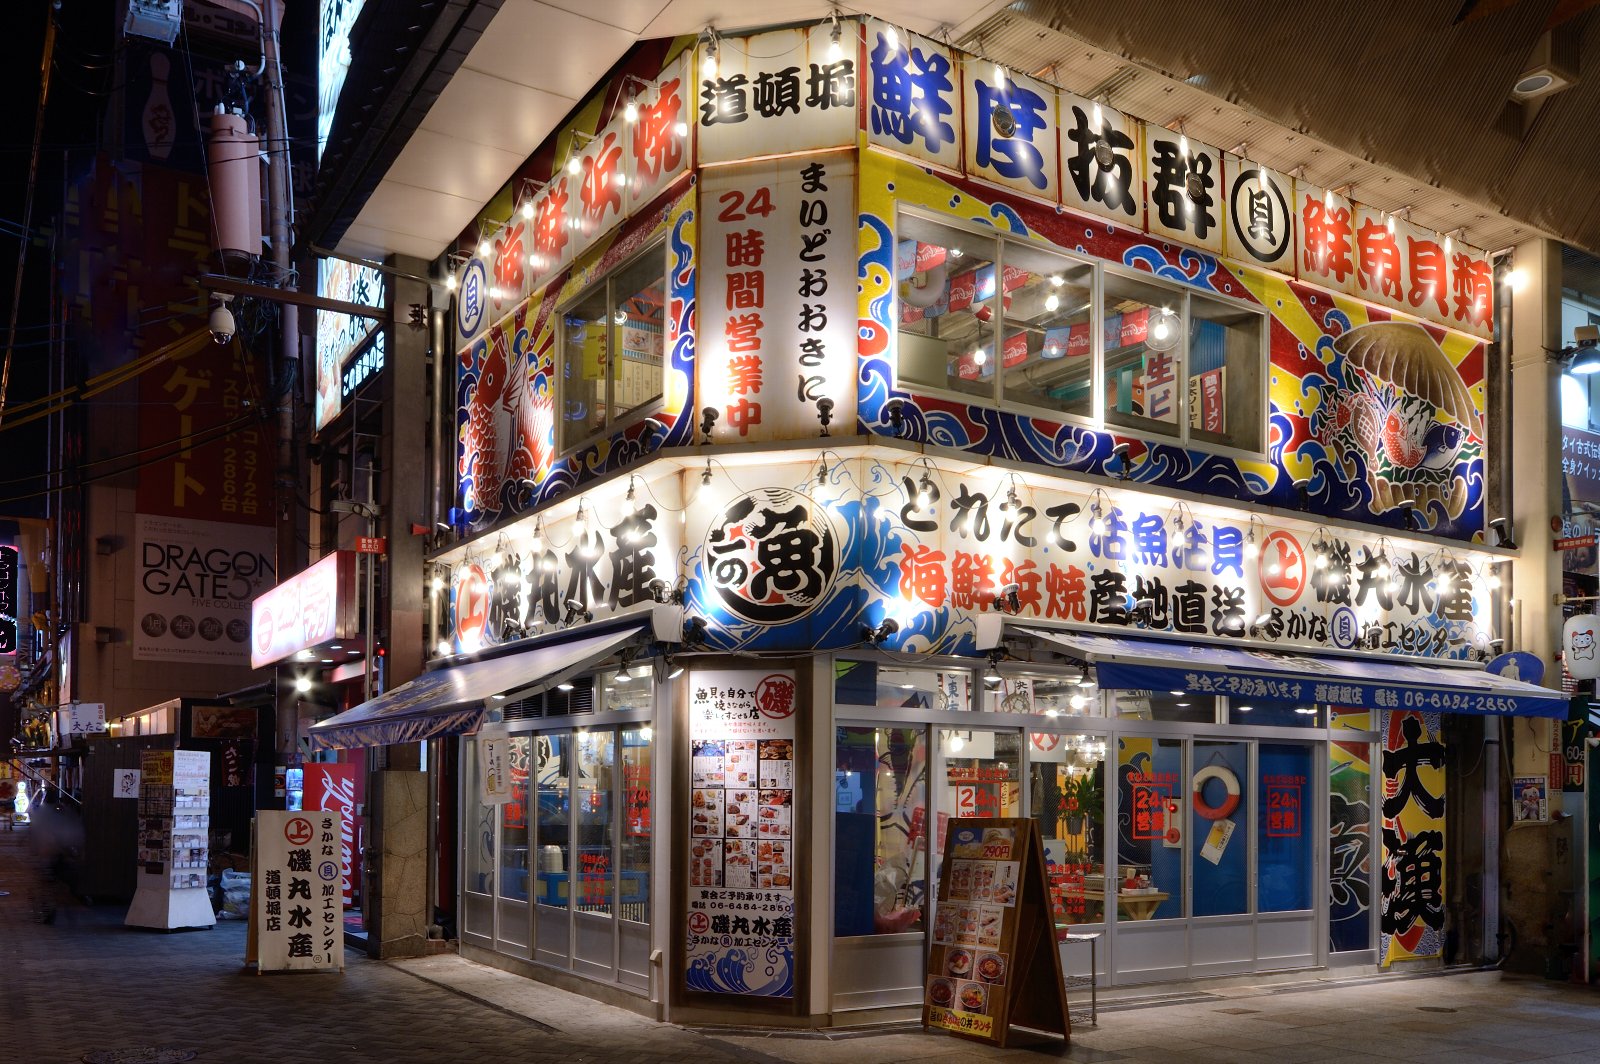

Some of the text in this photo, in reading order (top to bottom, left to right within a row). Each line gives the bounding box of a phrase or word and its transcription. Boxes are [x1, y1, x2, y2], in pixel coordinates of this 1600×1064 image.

[699, 61, 855, 127] 道頓堀
[494, 77, 682, 309] 海鮮浜焼
[871, 31, 1216, 240] 鮮度抜群
[1302, 194, 1494, 333] 鮮魚貝類
[797, 163, 832, 402] まいどおおきに
[717, 188, 777, 437] 24時間営業中
[1562, 456, 1600, 481] 全身クイッ
[143, 542, 275, 578] DRAGON
[143, 569, 228, 600] GATE
[1310, 537, 1474, 623] 磯丸水産
[192, 598, 211, 608] FIVE
[694, 687, 757, 704] 魚貝を自分で
[715, 700, 751, 711] 焼きながら
[1184, 673, 1518, 713] 宴会ご予約承ります 道頓堀店 電話 06-6484-2850
[1271, 792, 1298, 809] 24h
[983, 845, 1010, 858] 290円
[265, 870, 282, 932] 道頓堀店
[286, 848, 313, 958] 磯丸水産
[692, 901, 791, 912] 電話 06-6484-2850
[700, 890, 782, 902] 宴会ご予約承ります
[711, 914, 792, 938] 磯丸水産
